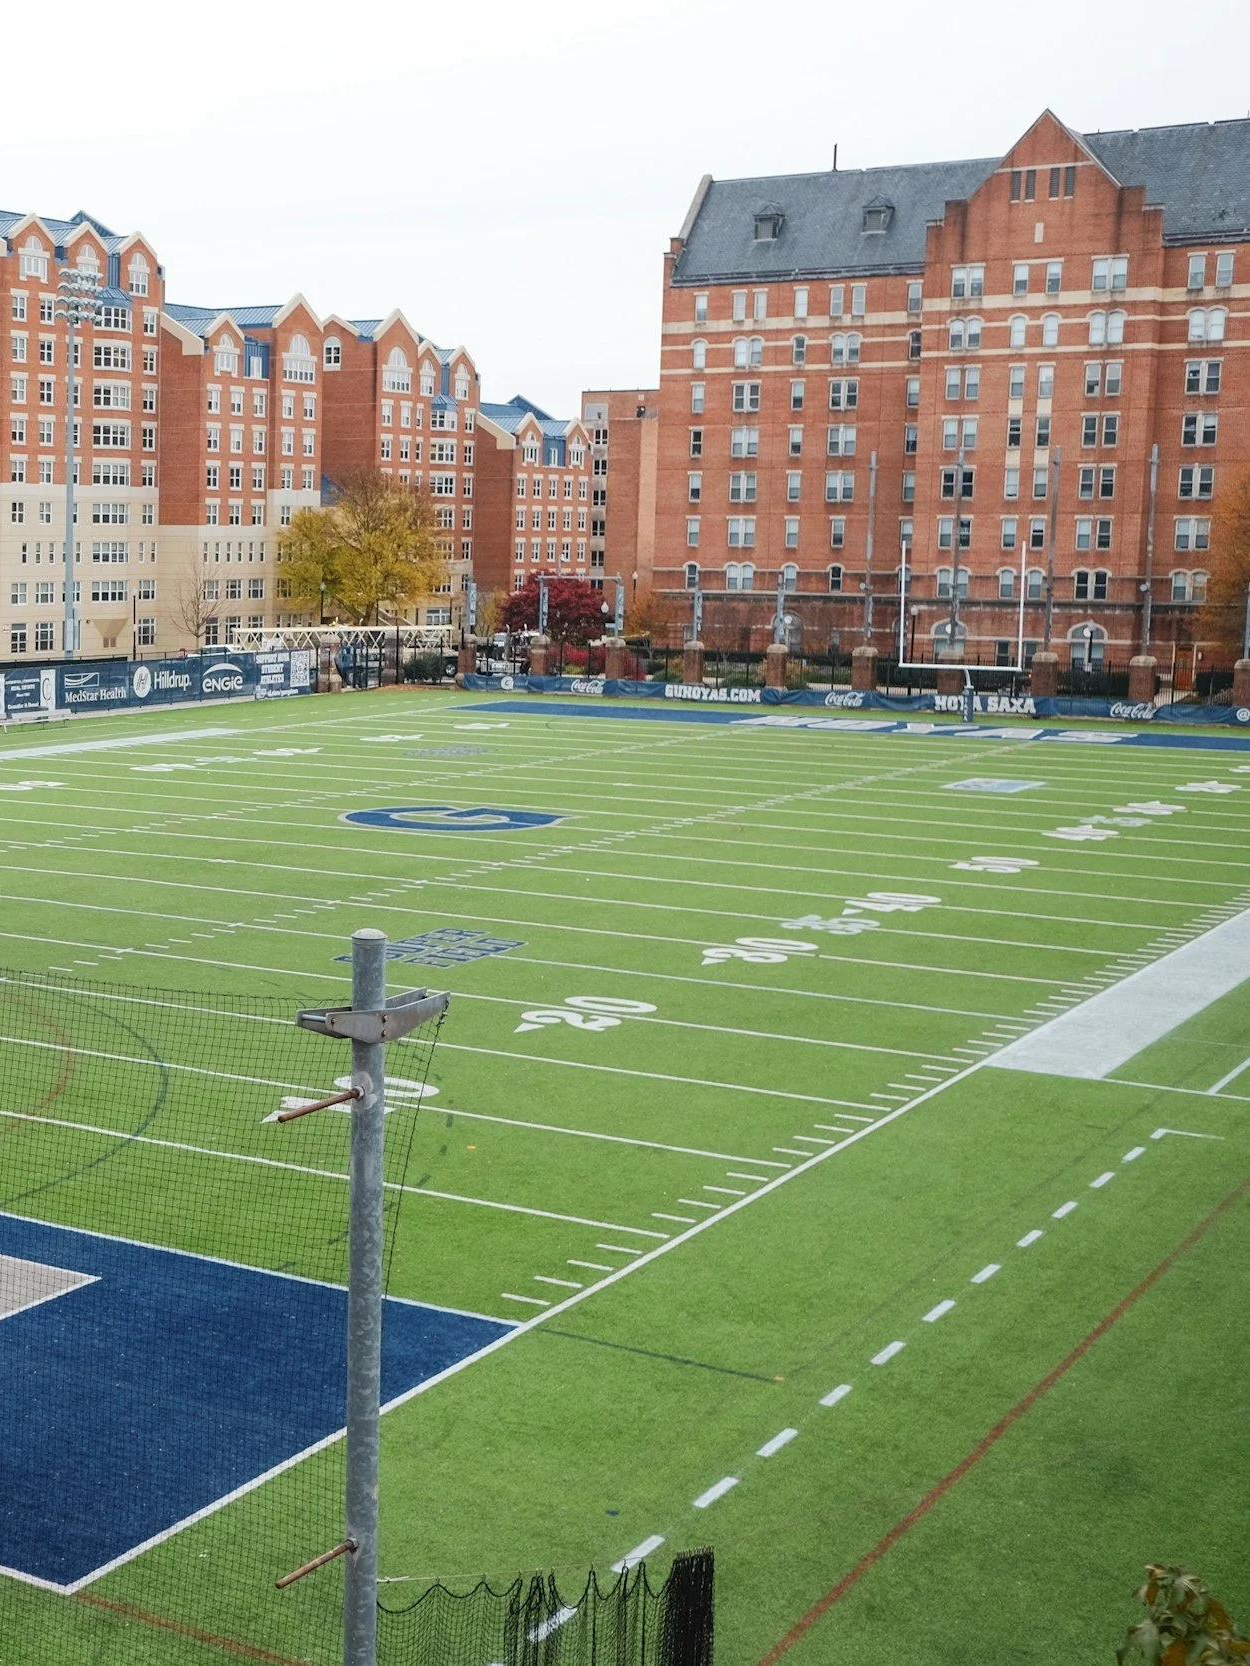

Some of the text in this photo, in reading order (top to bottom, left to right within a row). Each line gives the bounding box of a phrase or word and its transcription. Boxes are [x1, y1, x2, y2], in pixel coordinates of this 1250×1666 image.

[64, 687, 127, 703] MedStar Health
[664, 684, 761, 703] GUHOYAS.COM
[987, 696, 1037, 713] SAXA
[845, 891, 943, 913] 40
[702, 937, 819, 964] 30
[521, 995, 658, 1032] 20
